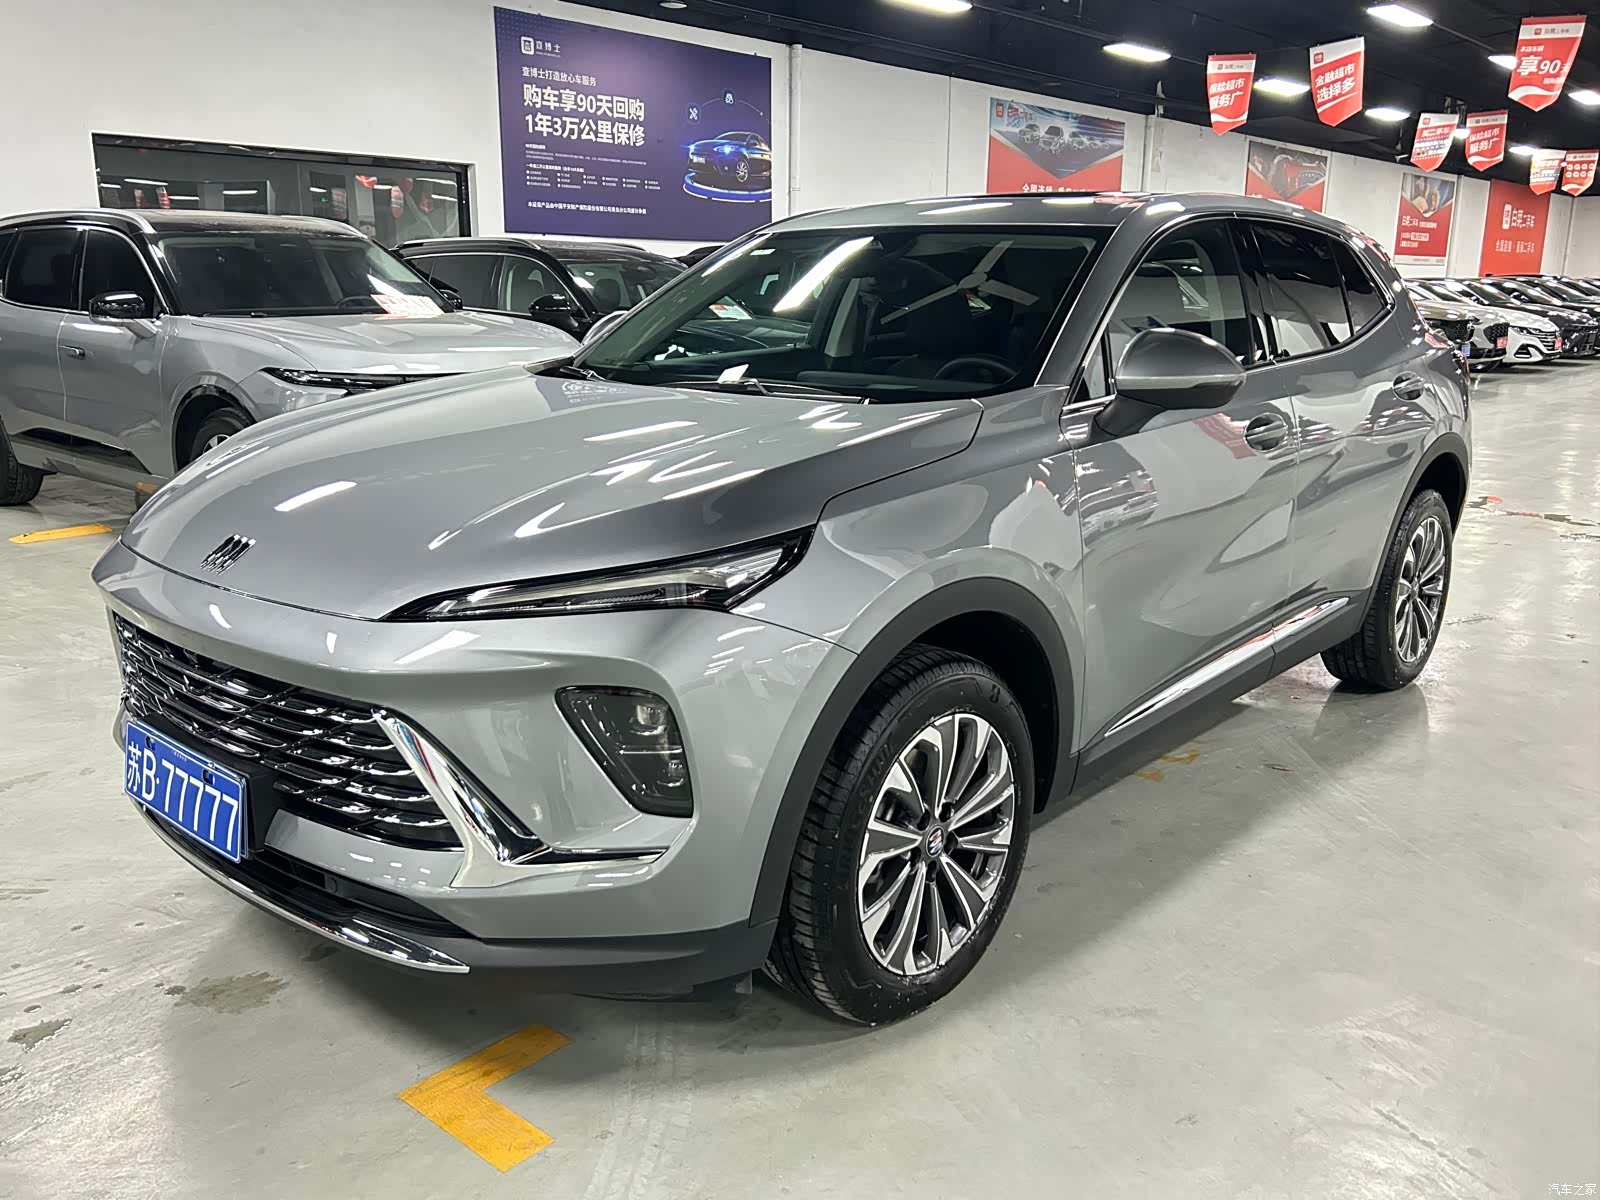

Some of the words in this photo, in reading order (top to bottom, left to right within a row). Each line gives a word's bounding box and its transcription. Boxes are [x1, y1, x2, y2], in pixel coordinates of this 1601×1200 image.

[522, 66, 597, 87] 查博士打造放心车服务
[1209, 78, 1245, 95] 保险超市
[1315, 63, 1355, 87] 金融超市
[523, 83, 645, 122] 购车享90天回购
[1209, 91, 1244, 110] 服务广
[1316, 77, 1356, 104] 选择多
[525, 112, 646, 147] 1年3万公里保修
[127, 741, 239, 852] 苏B·77777
